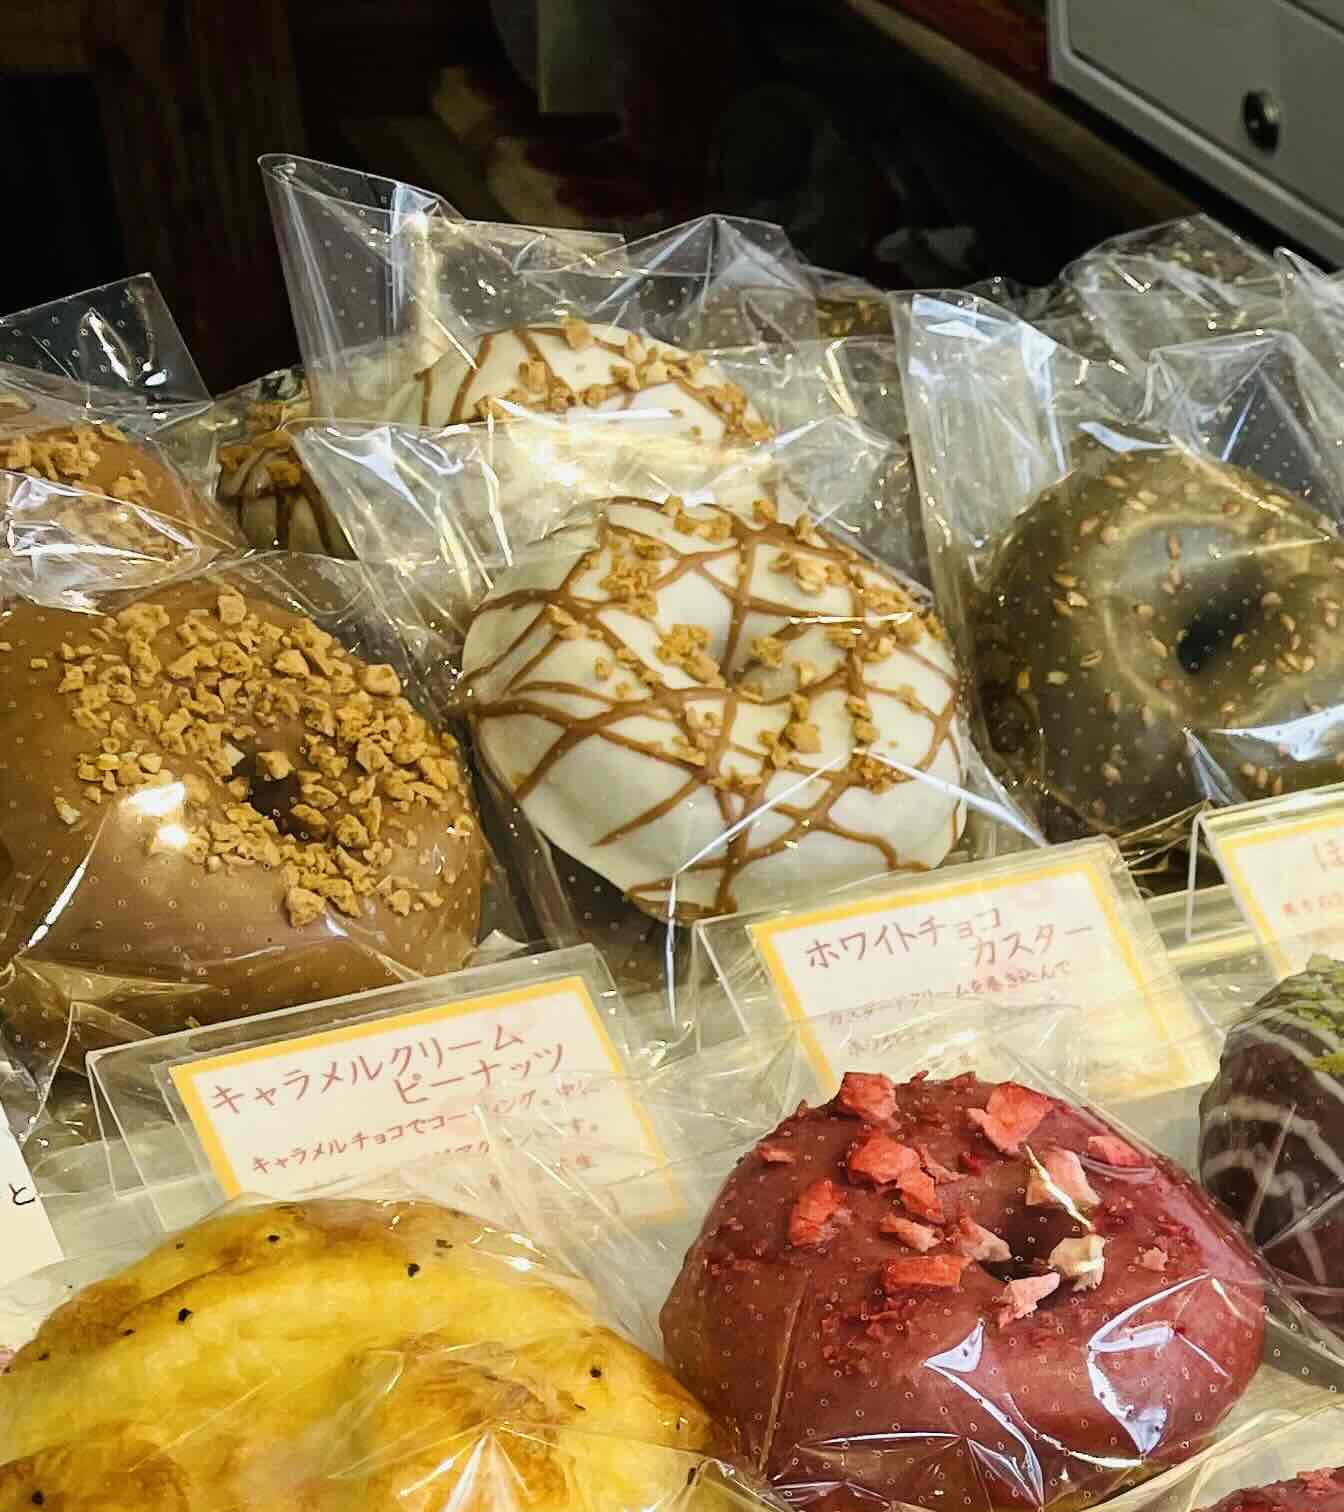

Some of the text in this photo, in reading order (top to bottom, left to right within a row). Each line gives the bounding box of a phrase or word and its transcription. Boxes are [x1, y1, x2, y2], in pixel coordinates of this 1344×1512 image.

[804, 907, 1002, 969] ホワイトチョコ
[210, 1023, 525, 1115] キャラメルクリーム
[393, 1042, 565, 1105] ピーナッツ
